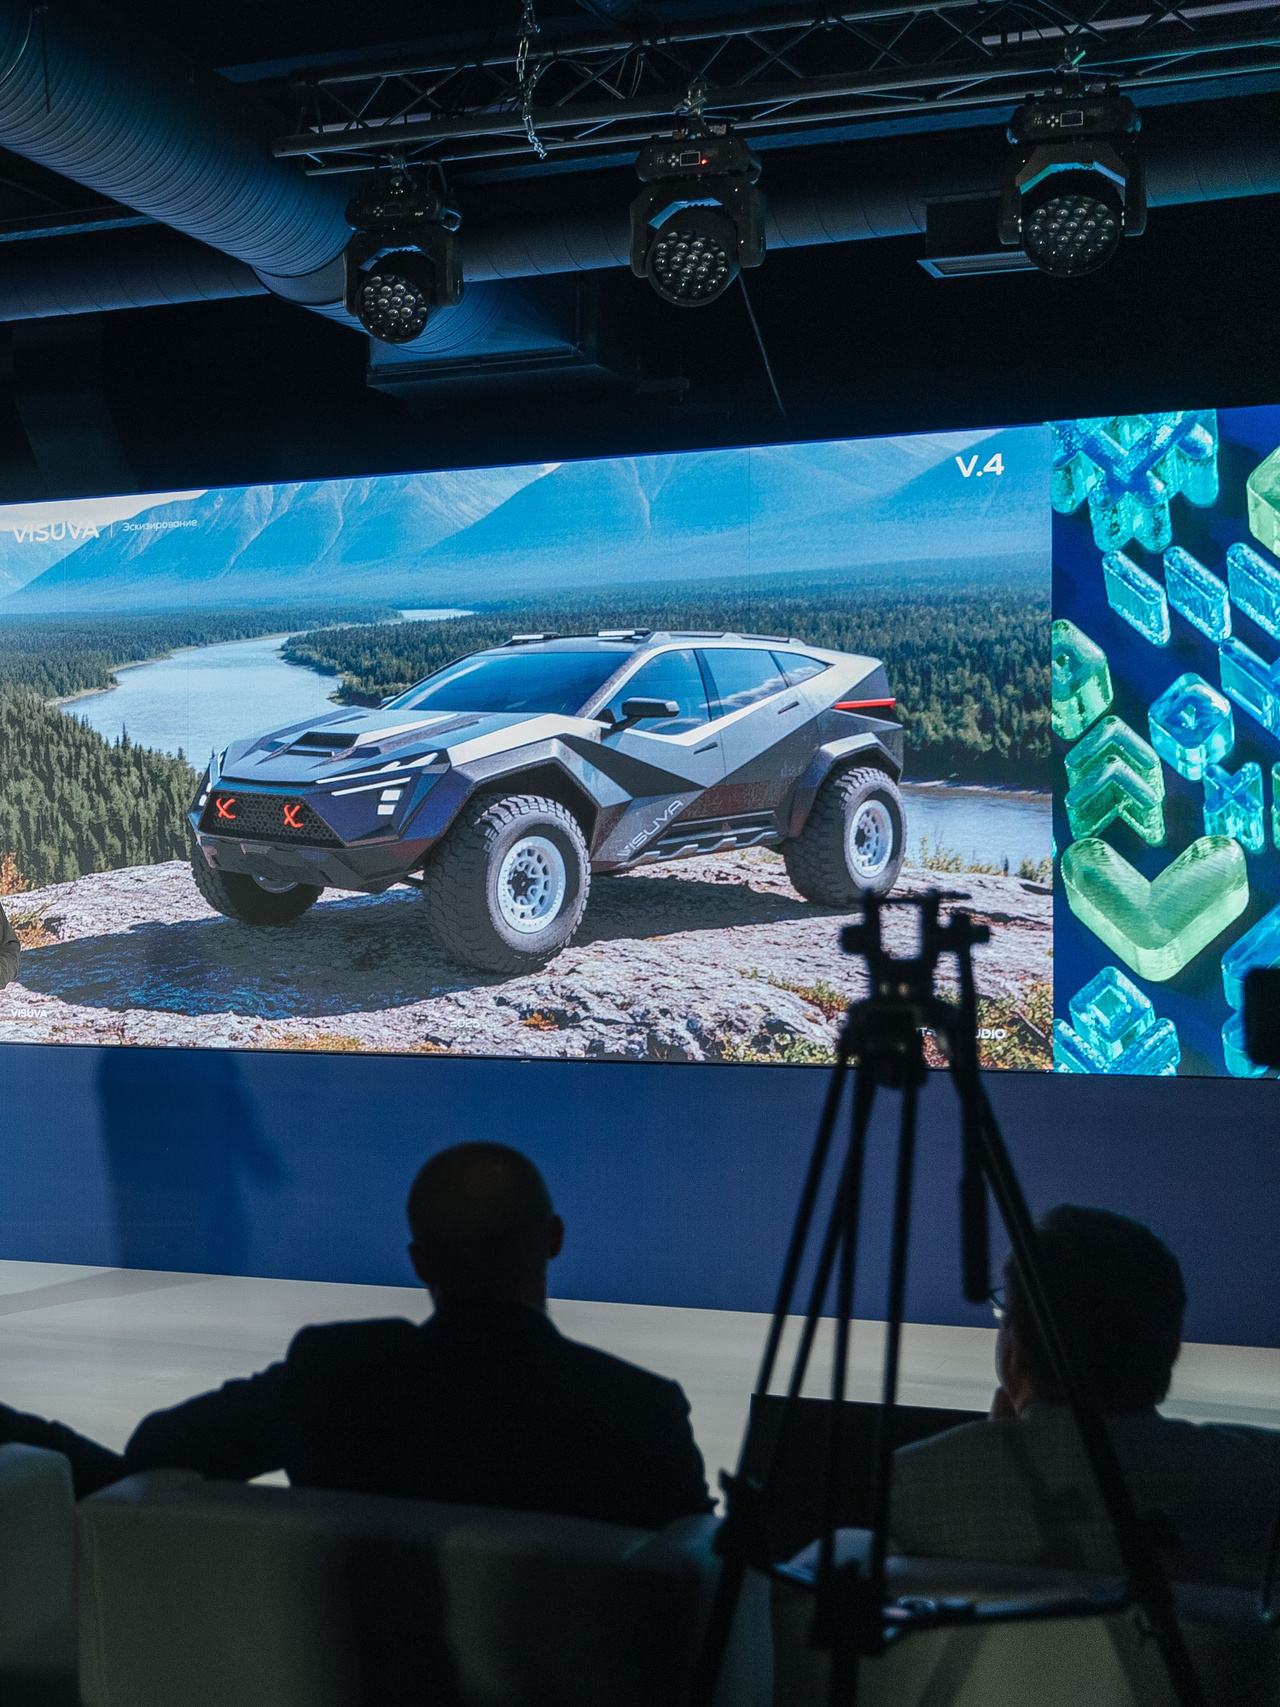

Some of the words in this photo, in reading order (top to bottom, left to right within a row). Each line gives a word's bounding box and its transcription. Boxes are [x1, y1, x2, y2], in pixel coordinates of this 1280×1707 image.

[955, 453, 1005, 478] V.4
[13, 520, 100, 544] VISUVA
[122, 519, 198, 533] Эскизирование
[617, 800, 684, 857] VISUVA
[10, 1008, 48, 1019] VISUVA
